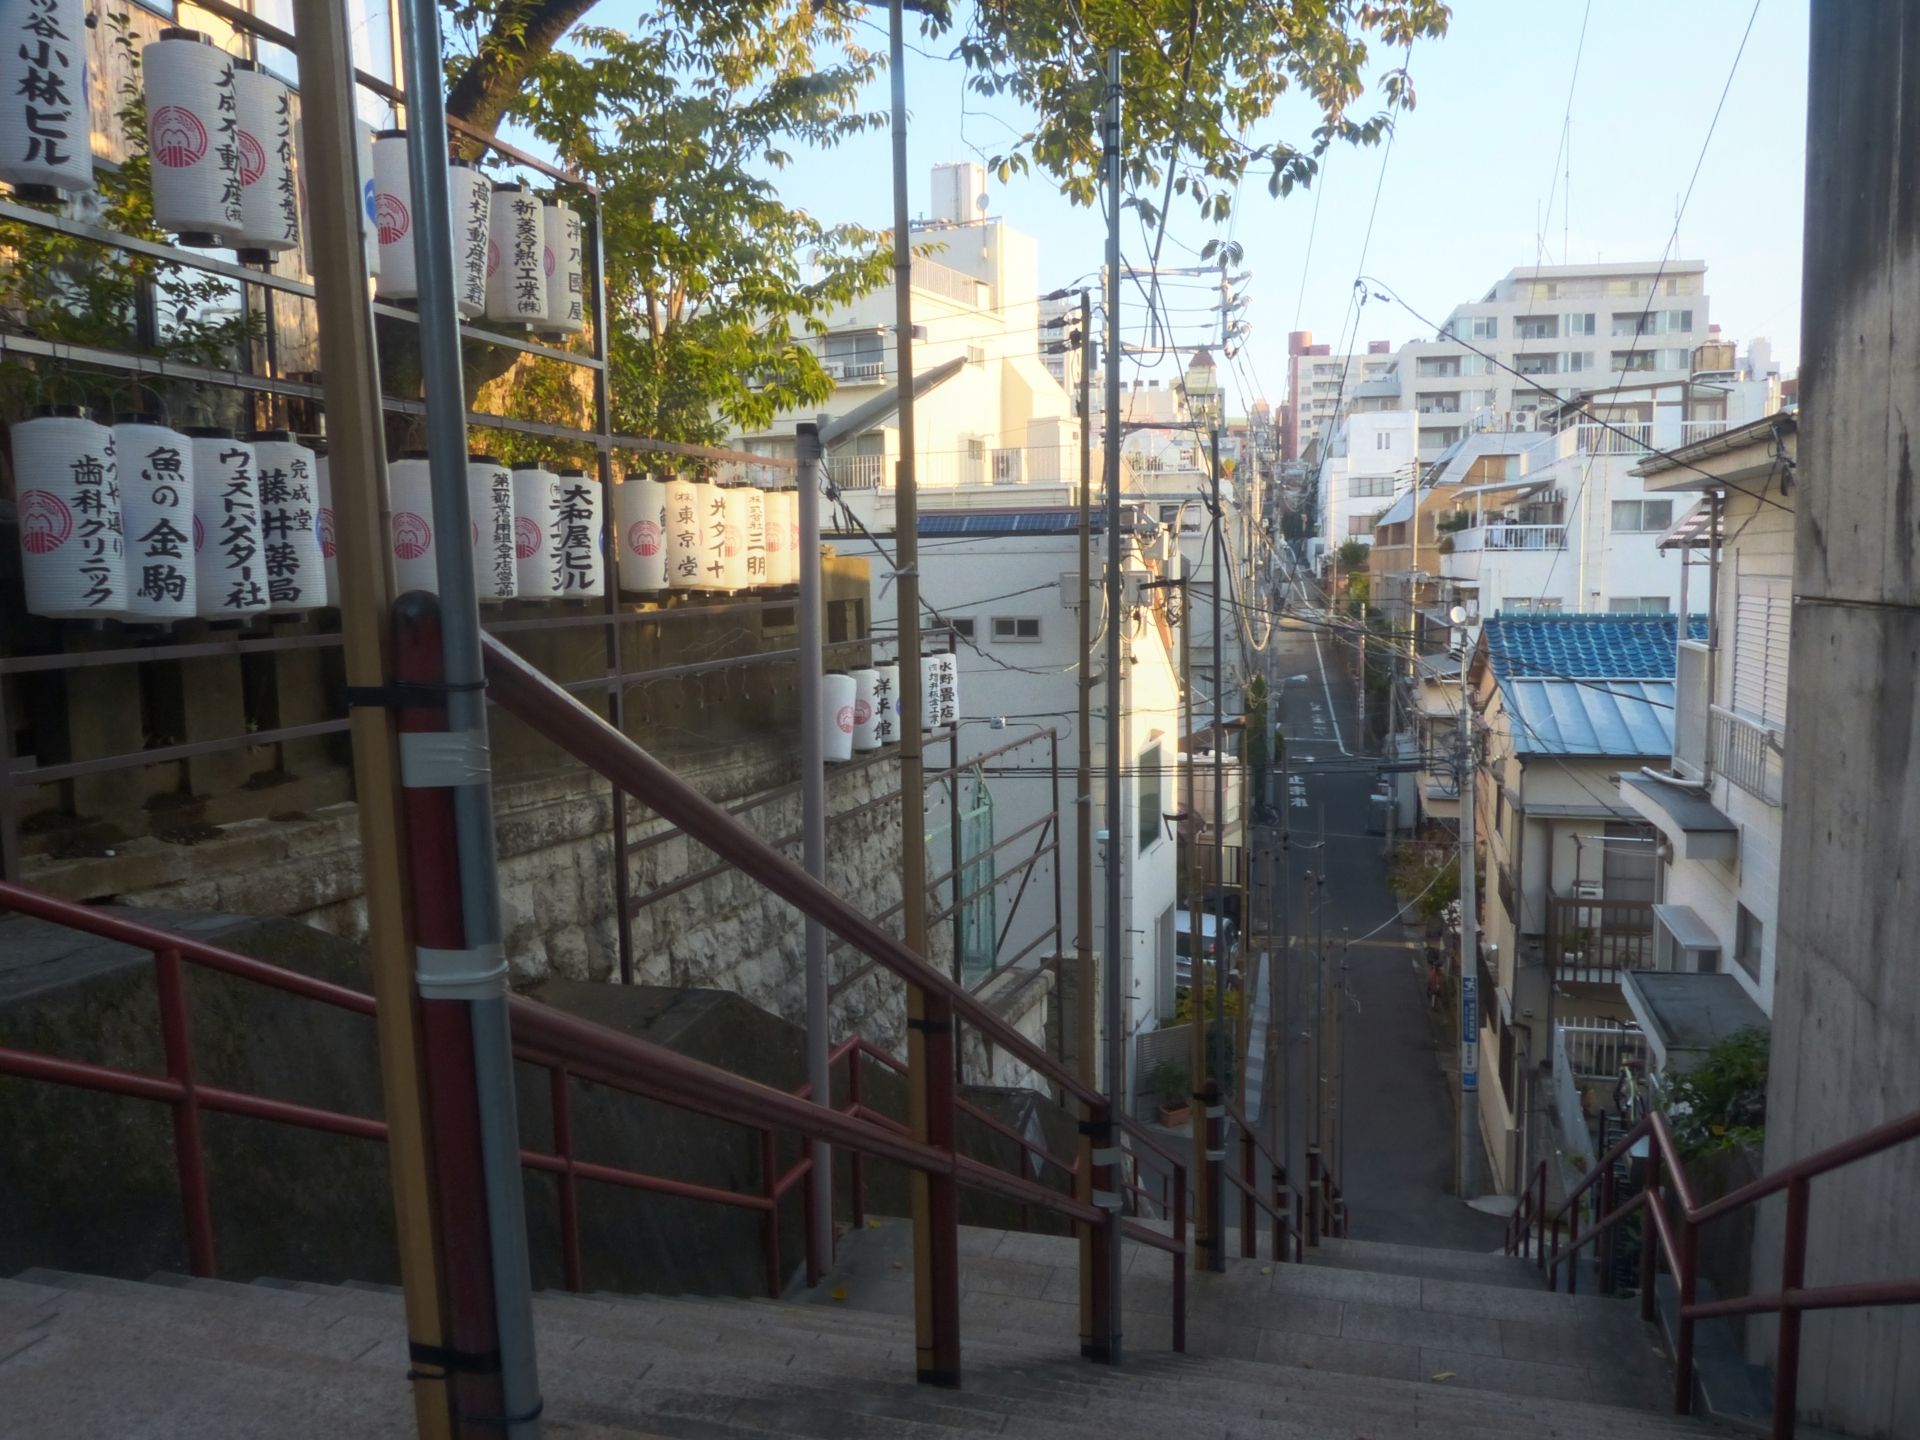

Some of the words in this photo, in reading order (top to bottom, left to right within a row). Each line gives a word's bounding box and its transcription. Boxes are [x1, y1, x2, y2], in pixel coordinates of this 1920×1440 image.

[511, 199, 542, 314] 新菱冷熱工業(株)
[69, 454, 113, 607] 歯科クリニック
[136, 446, 190, 603] 魚の金駒
[258, 468, 301, 603] 藤井薬局
[290, 458, 313, 533] 完成堂
[561, 484, 596, 591] 大和屋ビル
